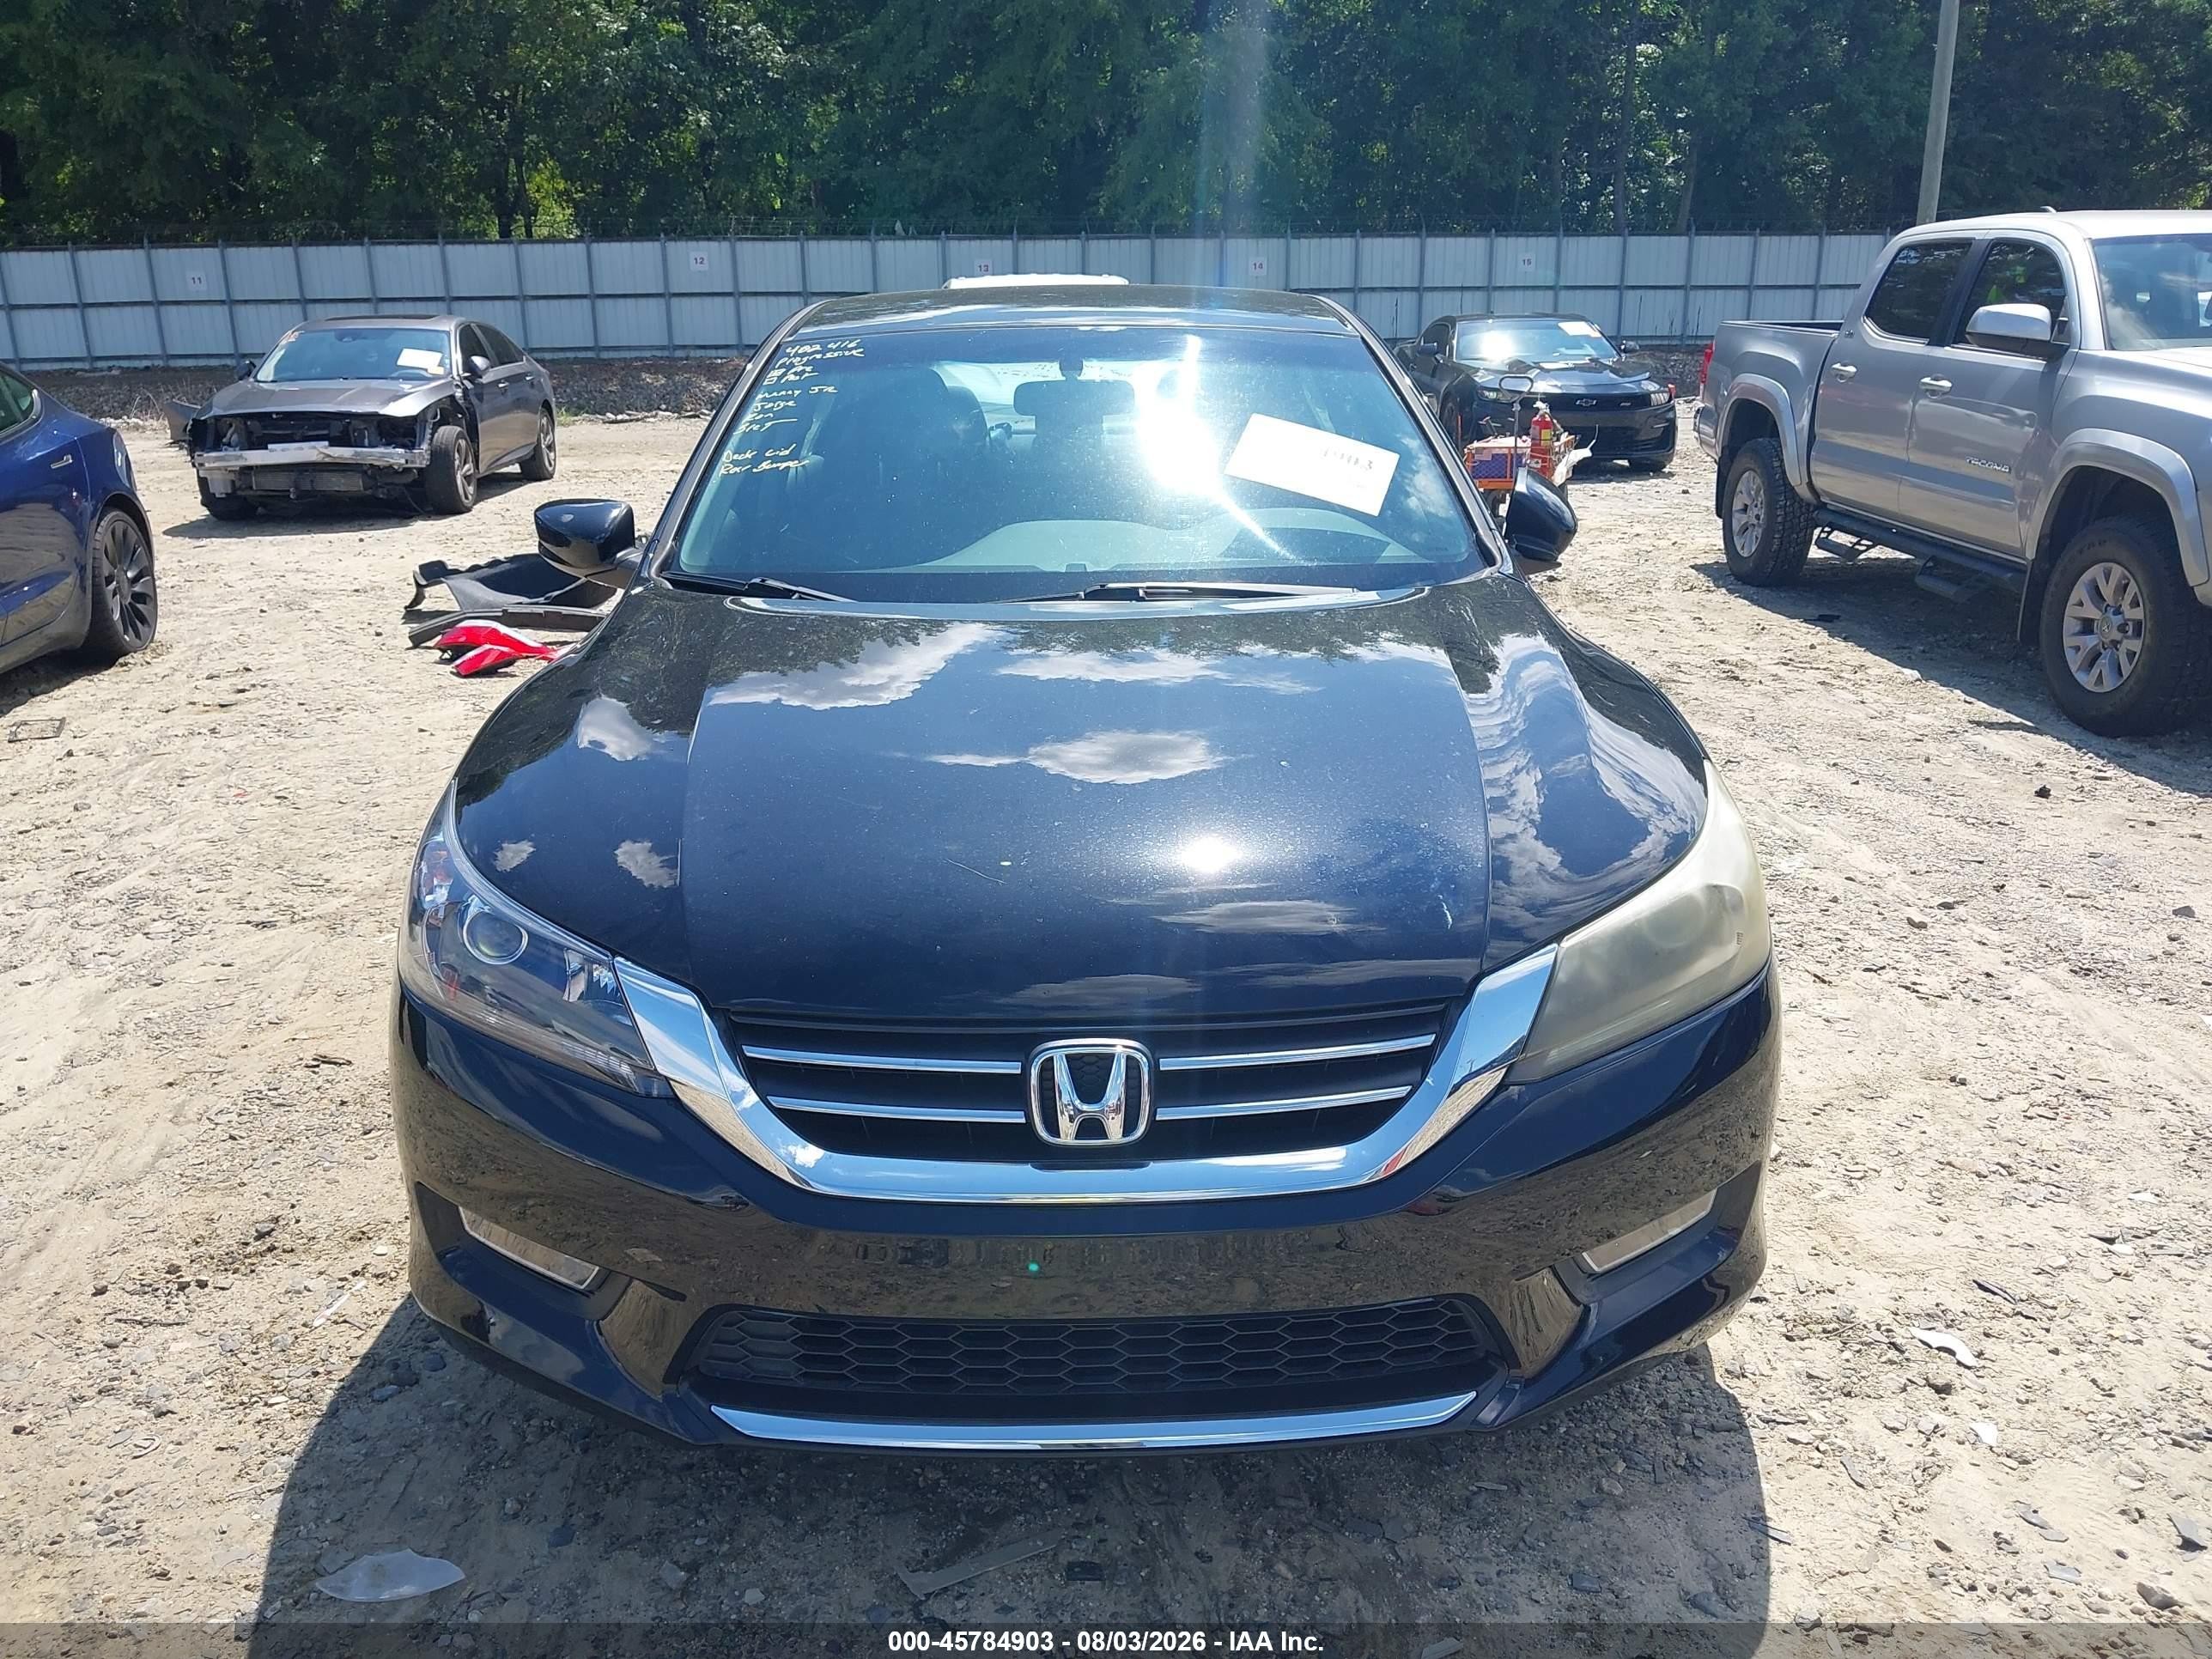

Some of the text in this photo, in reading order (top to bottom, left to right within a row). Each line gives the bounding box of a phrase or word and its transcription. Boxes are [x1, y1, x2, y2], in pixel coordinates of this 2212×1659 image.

[694, 257, 705, 265] 12
[1253, 262, 1263, 270] 14
[827, 338, 861, 349] 416
